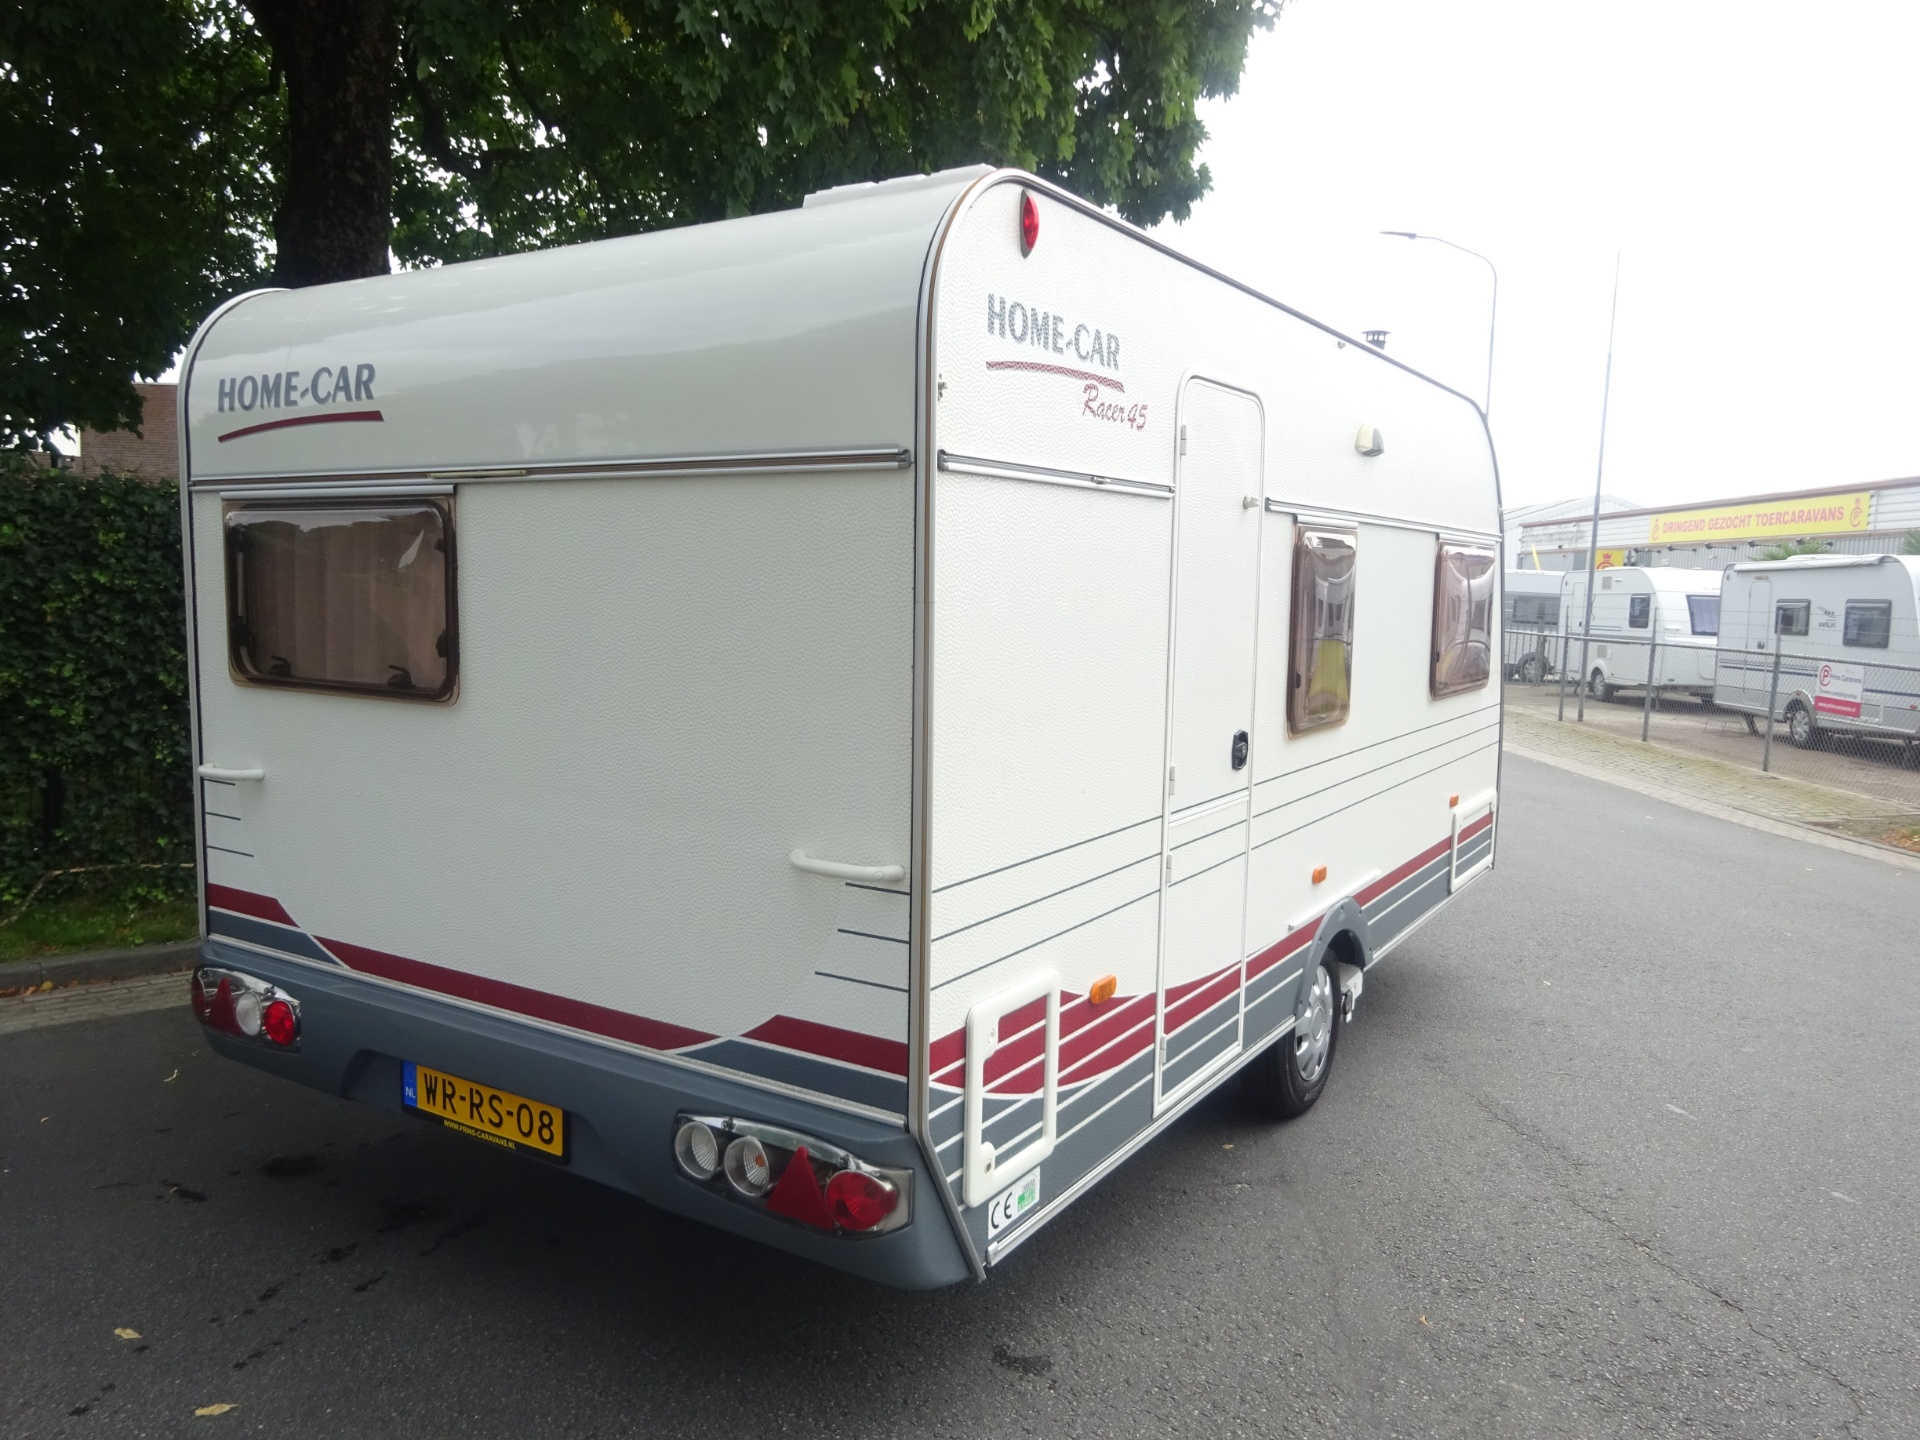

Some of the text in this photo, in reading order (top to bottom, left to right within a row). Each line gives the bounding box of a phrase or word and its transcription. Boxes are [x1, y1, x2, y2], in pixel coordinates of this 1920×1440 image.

[987, 293, 1120, 371] HOME-CAR
[218, 363, 375, 413] HOME-CAR
[1082, 383, 1149, 431] Racer 45
[1662, 519, 1705, 534] DRINGEND
[1708, 515, 1752, 531] GEZOCHT
[1755, 506, 1845, 527] TOERCARAVANS
[1818, 621, 1837, 629] WILK
[405, 1086, 417, 1099] NL
[424, 1072, 555, 1145] WR-RS-08
[443, 1119, 517, 1150] WWW.PRINS-CARAVANS.NL
